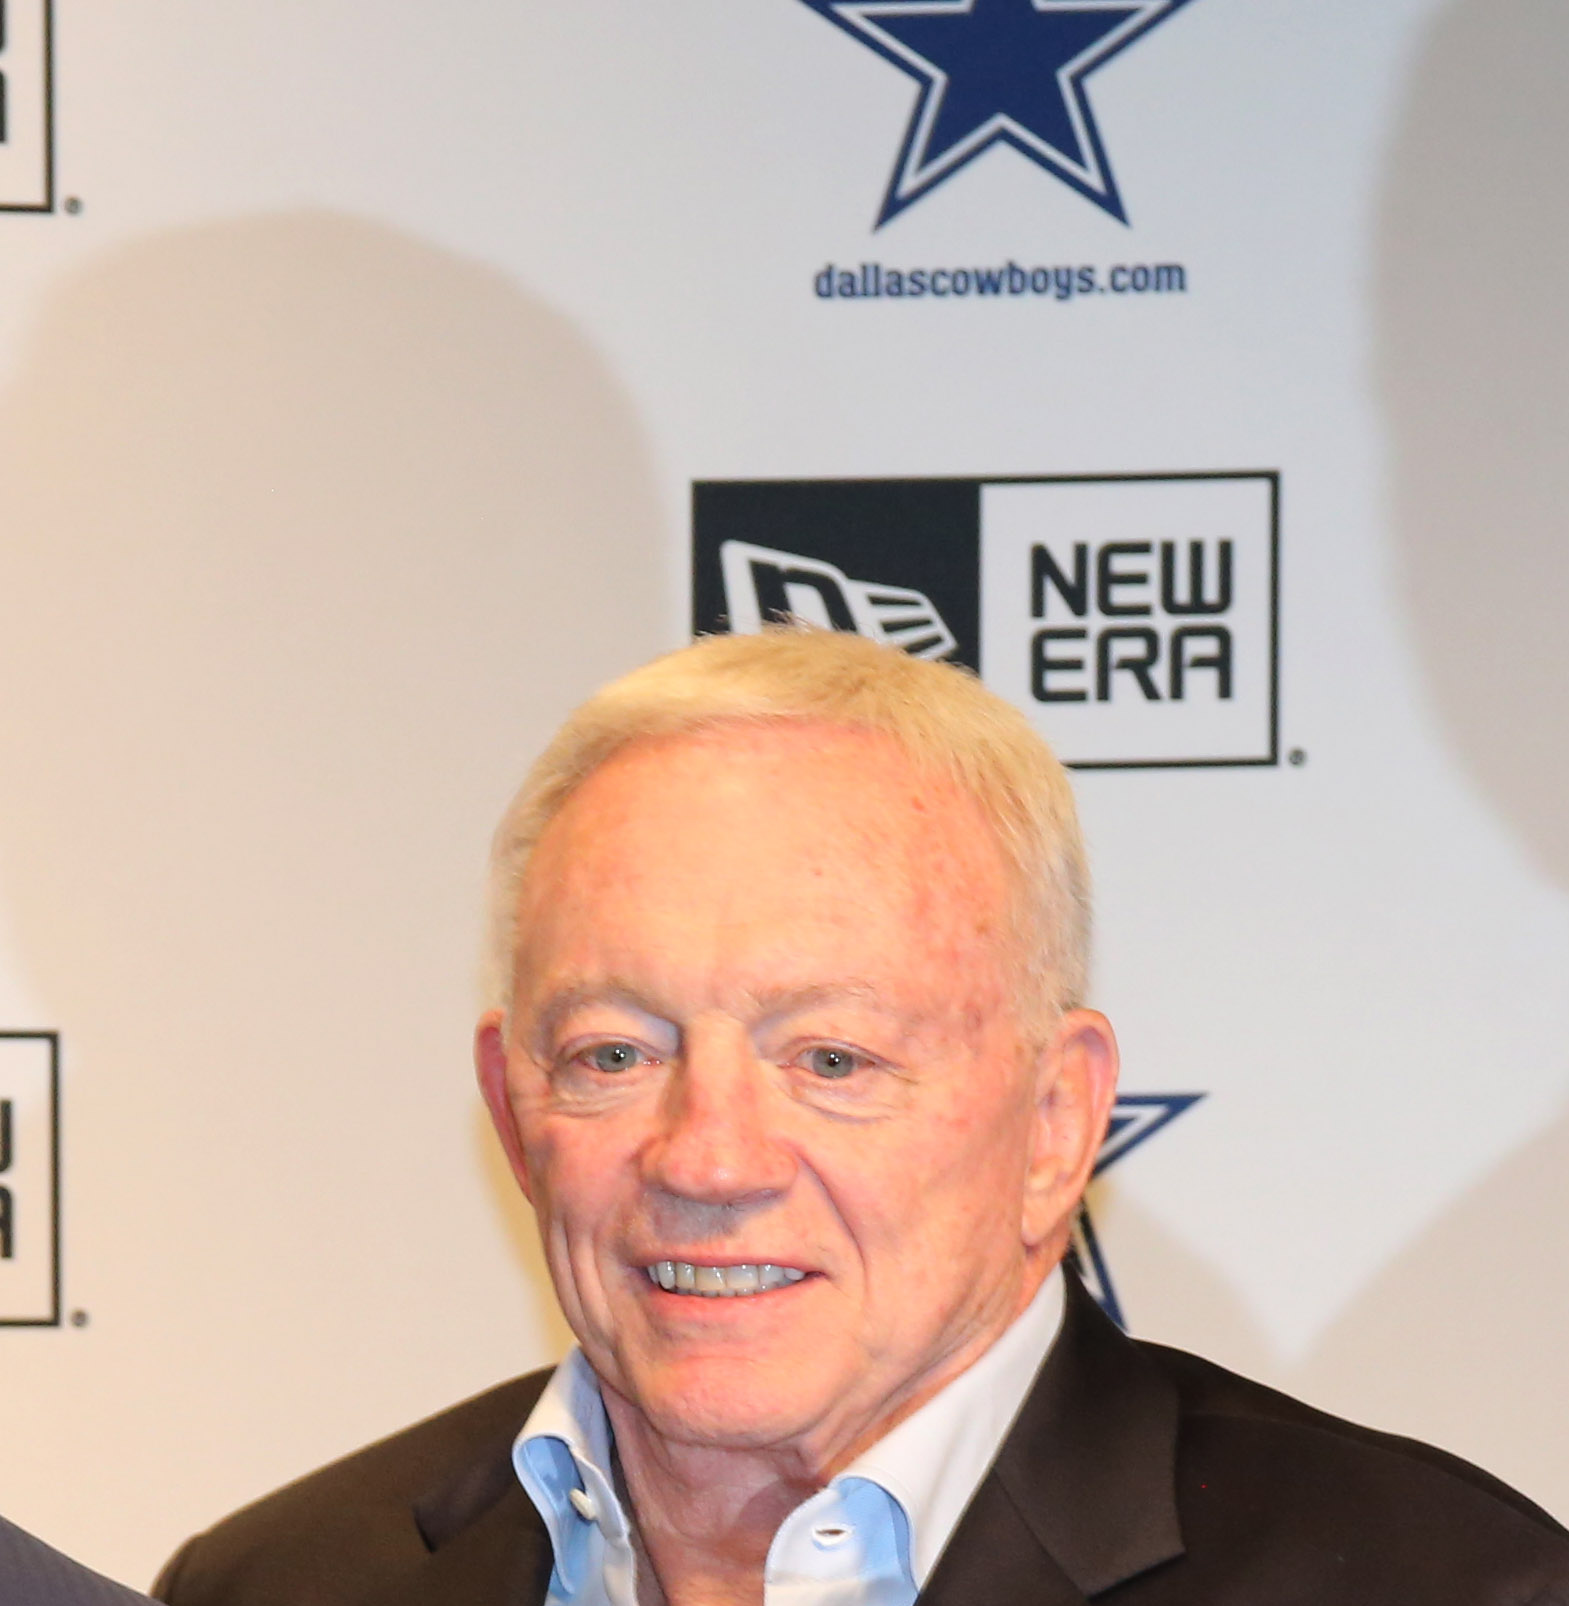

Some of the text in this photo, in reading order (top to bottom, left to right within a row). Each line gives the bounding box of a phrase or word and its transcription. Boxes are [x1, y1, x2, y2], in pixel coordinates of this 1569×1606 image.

[814, 261, 1187, 301] dallascowboys.com
[1031, 539, 1234, 618] NEW
[1031, 626, 1232, 702] ERA
